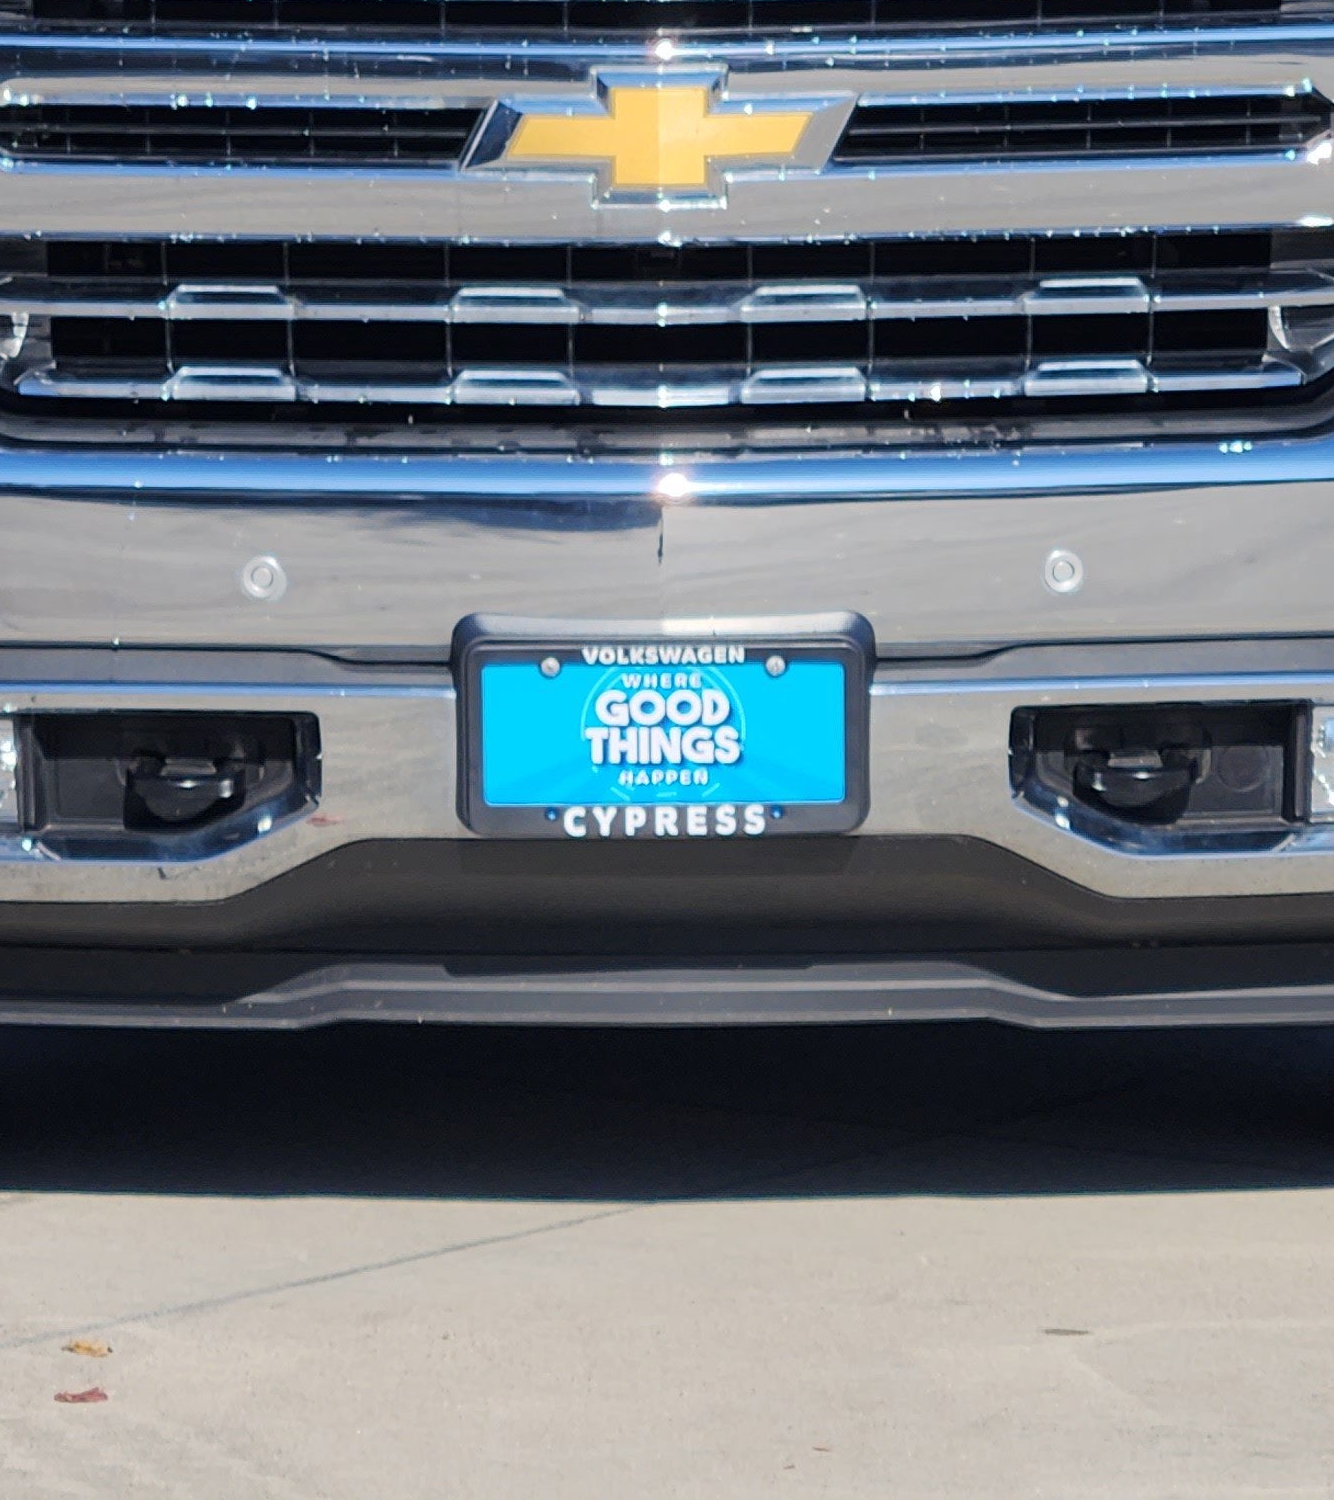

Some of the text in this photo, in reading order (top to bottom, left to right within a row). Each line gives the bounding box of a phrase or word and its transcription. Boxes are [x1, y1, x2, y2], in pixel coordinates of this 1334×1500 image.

[581, 645, 746, 665] VOLKSWAGEN
[621, 672, 703, 689] WHERE
[595, 688, 731, 727] GOOD
[584, 725, 742, 765] THINGS
[618, 768, 709, 786] HAPPEN
[563, 804, 766, 838] CYPRESS
